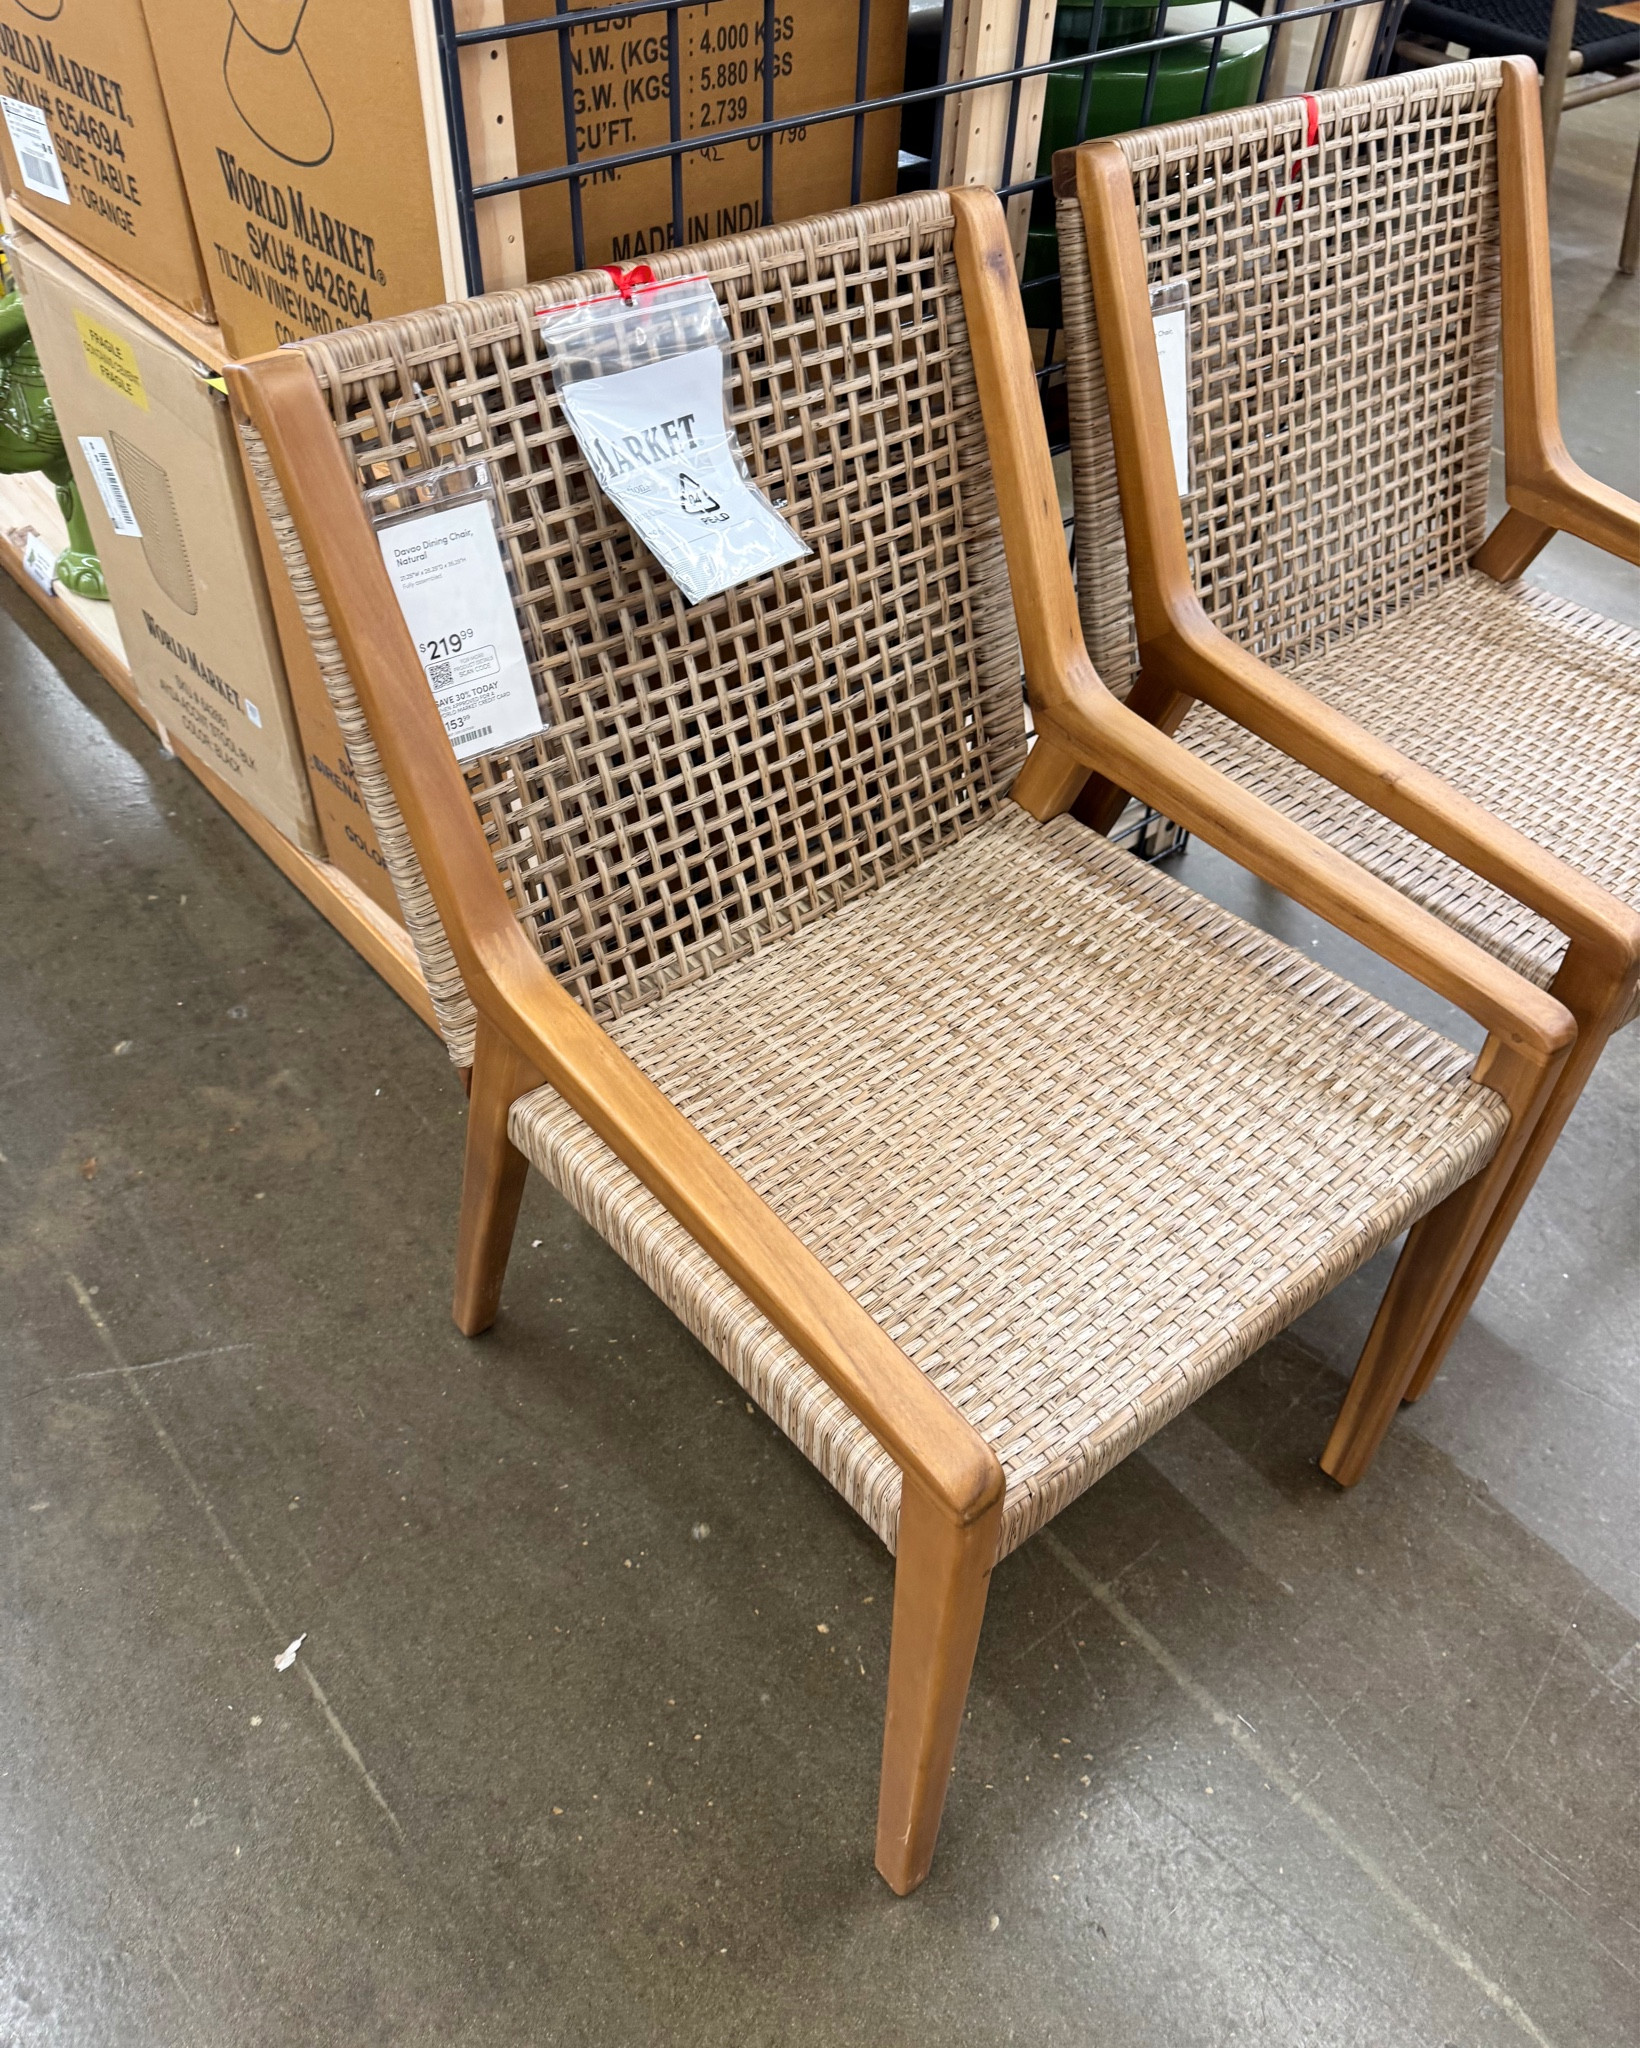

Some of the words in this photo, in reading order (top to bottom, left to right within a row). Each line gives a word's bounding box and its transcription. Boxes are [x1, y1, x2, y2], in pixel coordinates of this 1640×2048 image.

[0, 22, 41, 75] ORLD
[569, 44, 614, 76] N.W.
[621, 35, 670, 74] (KGS
[701, 23, 748, 54] 4.000
[755, 15, 794, 46] KGS
[572, 82, 616, 115] G.W.
[623, 72, 671, 112] (KGS
[701, 60, 748, 92] 5.880
[753, 52, 793, 82] KGS
[55, 97, 125, 163] 654694
[701, 96, 747, 128] 2.739
[54, 132, 90, 176] SIDE
[89, 152, 142, 206] TABLE
[216, 146, 288, 230] WORLD
[80, 184, 136, 237] ORANGE
[688, 213, 709, 244] IN
[716, 200, 766, 233] INDI
[213, 242, 263, 299] TILTON
[261, 271, 333, 334] VINEYARD
[246, 221, 298, 282] SKU#
[302, 254, 373, 322] 642664
[89, 329, 123, 360] FRAGILE
[100, 365, 134, 396] FRAGILE
[394, 545, 422, 558] Davao
[422, 538, 448, 550] Dining
[449, 529, 474, 541] Chair,
[396, 551, 428, 567] Natural
[142, 608, 187, 664] WORLD
[456, 691, 471, 701] 30%
[472, 681, 498, 695] TODAY
[459, 668, 474, 677] SCAN
[476, 663, 491, 672] CODE
[441, 710, 457, 719] ORLD
[457, 702, 478, 713] MARKET
[497, 691, 511, 700] CARD
